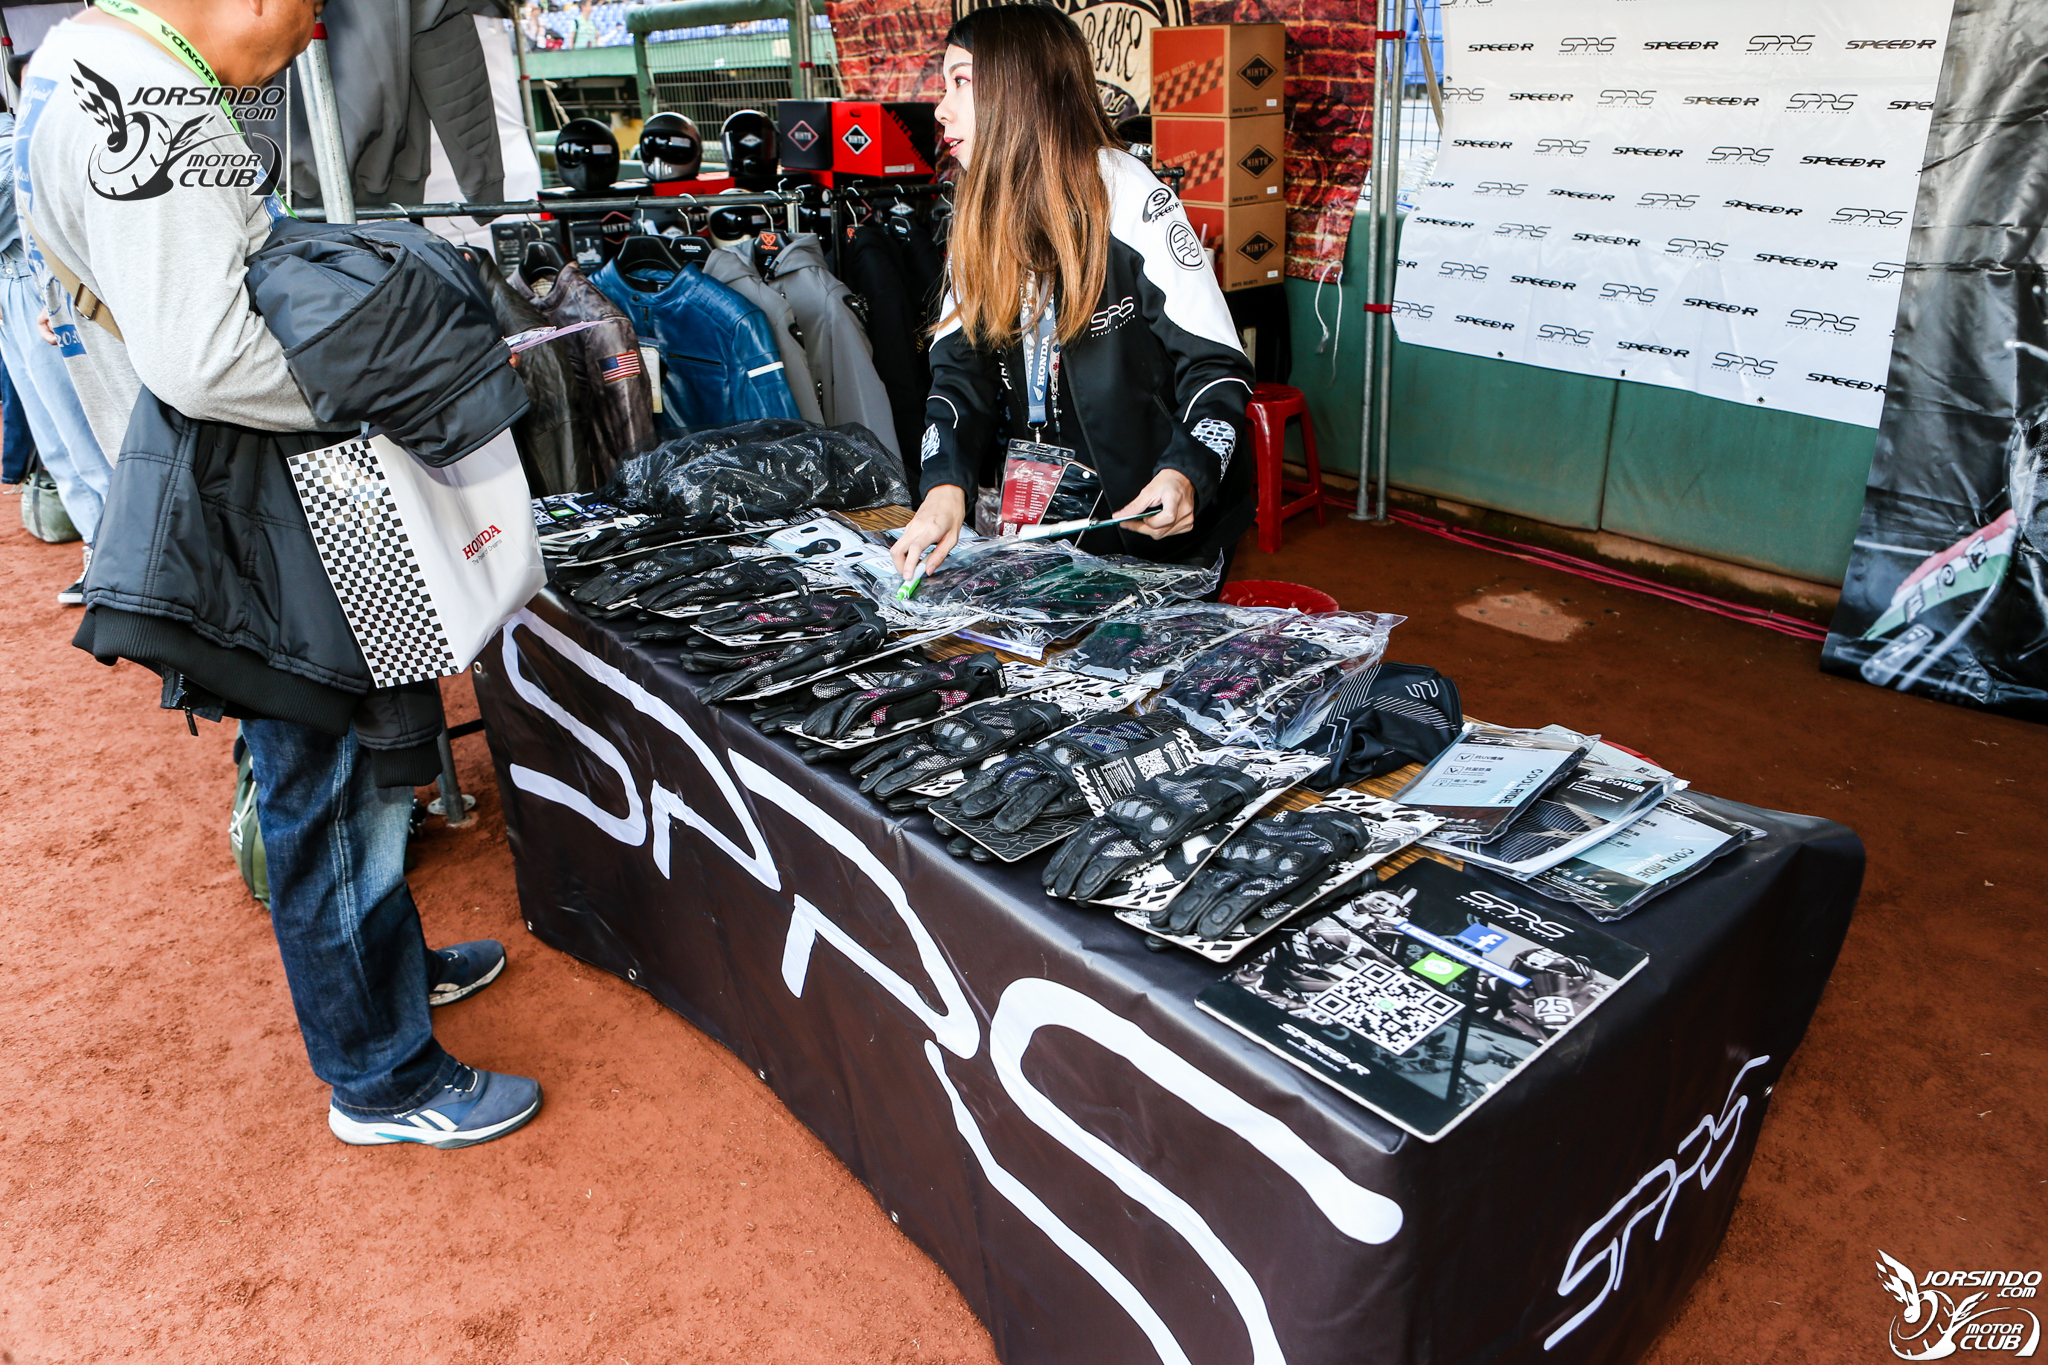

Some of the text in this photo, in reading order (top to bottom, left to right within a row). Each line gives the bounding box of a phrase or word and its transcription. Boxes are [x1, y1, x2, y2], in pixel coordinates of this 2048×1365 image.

[160, 24, 217, 85] HONDA
[1246, 67, 1269, 77] NINTH
[1247, 156, 1269, 167] NINTH
[1246, 242, 1269, 253] NINTH
[462, 524, 502, 560] HONDA
[1498, 768, 1544, 804] COOL RIDE
[1579, 774, 1606, 783] ARM
[1606, 779, 1646, 793] COVER
[1536, 998, 1572, 1017] 25
